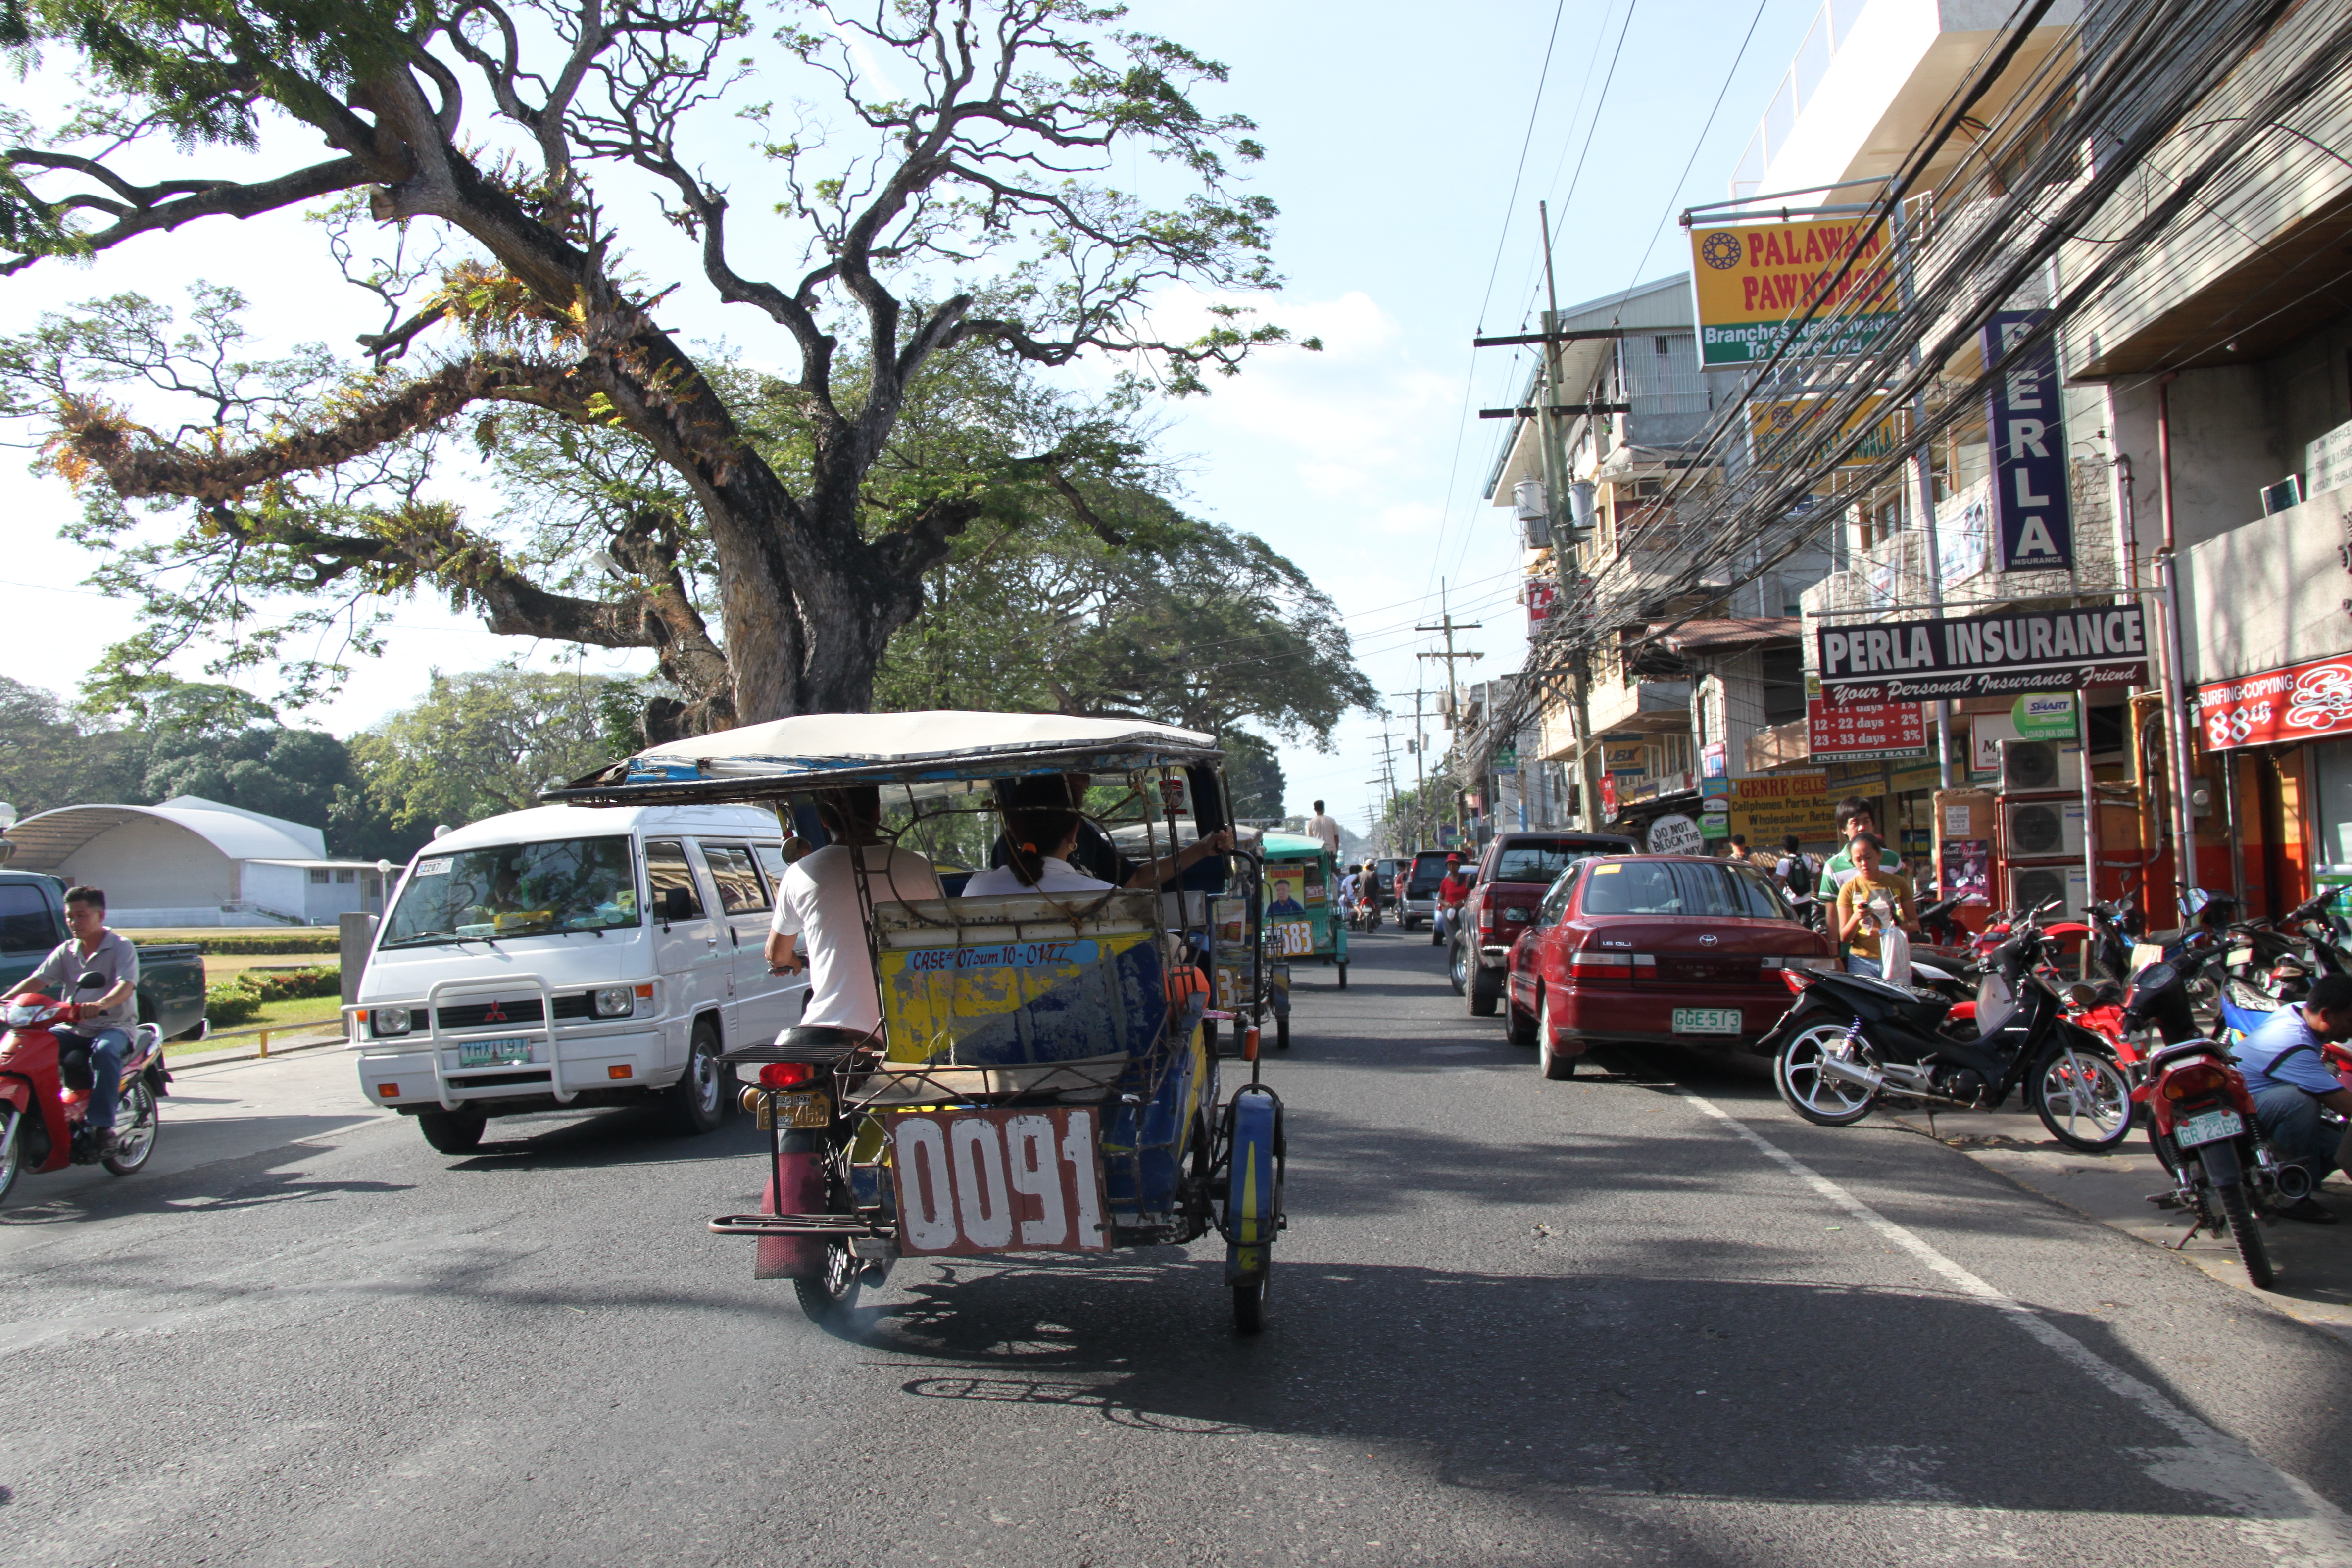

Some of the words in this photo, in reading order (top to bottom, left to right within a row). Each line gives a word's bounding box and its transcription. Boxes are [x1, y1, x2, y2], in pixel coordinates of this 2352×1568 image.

[1747, 224, 1881, 268] PALAWAN
[1742, 268, 1888, 311] PAWNSHOP
[1705, 323, 1790, 344] Branches
[1746, 341, 1767, 358] To
[2001, 322, 2058, 557] PERLA
[2314, 439, 2326, 454] LAW
[2330, 425, 2351, 445] OFFICE
[2312, 476, 2332, 494] NOTARY
[2011, 556, 2063, 566] INSURANCE
[1824, 626, 1935, 674] PERLA
[1945, 610, 2143, 665] INSURANCE
[1833, 684, 1881, 706] Your
[1887, 675, 1973, 702] Personal
[1978, 673, 2073, 694] Insurance
[2079, 665, 2138, 688] Friend
[2029, 701, 2069, 711] SMART
[1814, 719, 1828, 730] 12
[1838, 718, 1854, 729] 22
[1857, 717, 1884, 730] days
[1901, 714, 1919, 726] 2%
[1814, 735, 1829, 746] 23
[1840, 734, 1855, 745] 33
[1858, 733, 1886, 745] days
[1903, 730, 1921, 741] 3%
[1817, 752, 1882, 761] INTEREST
[1885, 749, 1920, 758] RATE
[1740, 778, 1790, 798] GENRE
[1654, 827, 1668, 840] DO
[1669, 821, 1688, 835] NOT
[1650, 835, 1684, 852] BLOCK
[1684, 832, 1700, 842] THE
[2181, 1128, 2199, 1145] GR
[2204, 1117, 2243, 1139] 2362
[895, 1109, 1105, 1251] 0091
